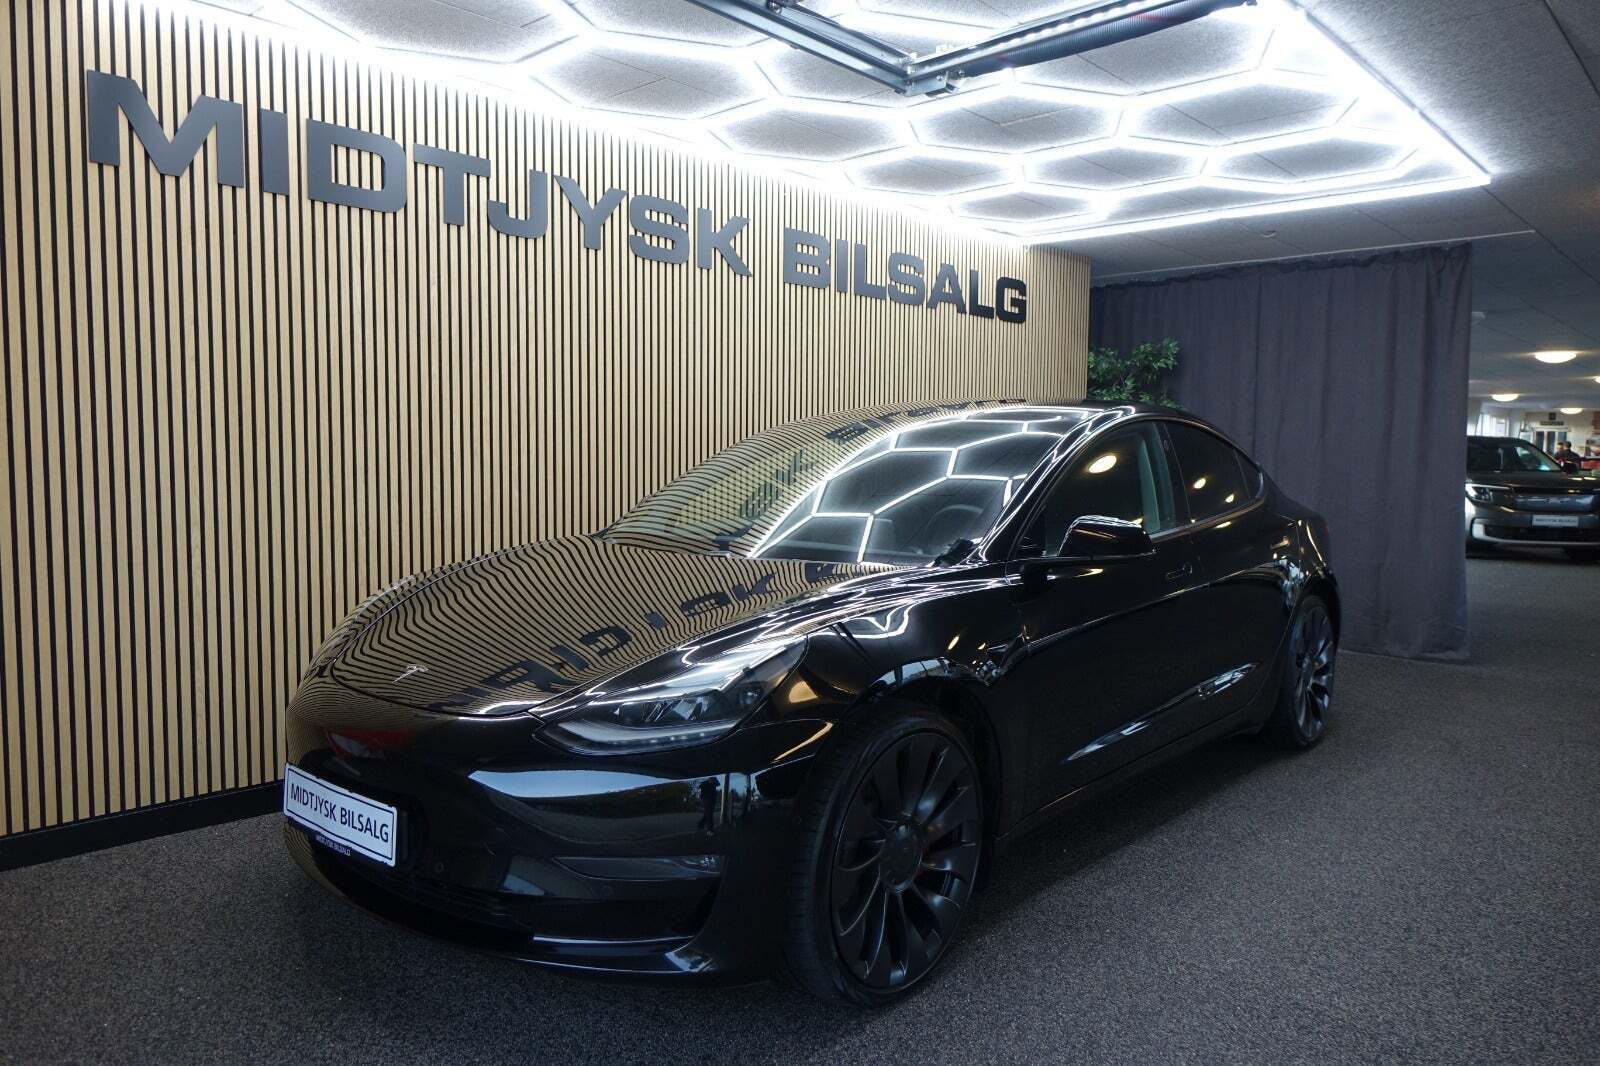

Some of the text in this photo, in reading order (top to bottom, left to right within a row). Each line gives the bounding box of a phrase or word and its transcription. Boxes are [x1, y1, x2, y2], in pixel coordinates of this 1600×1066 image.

[86, 70, 1027, 324] MIDTJYSK BILSALG
[290, 783, 389, 843] MIDTJYSK BILSALG
